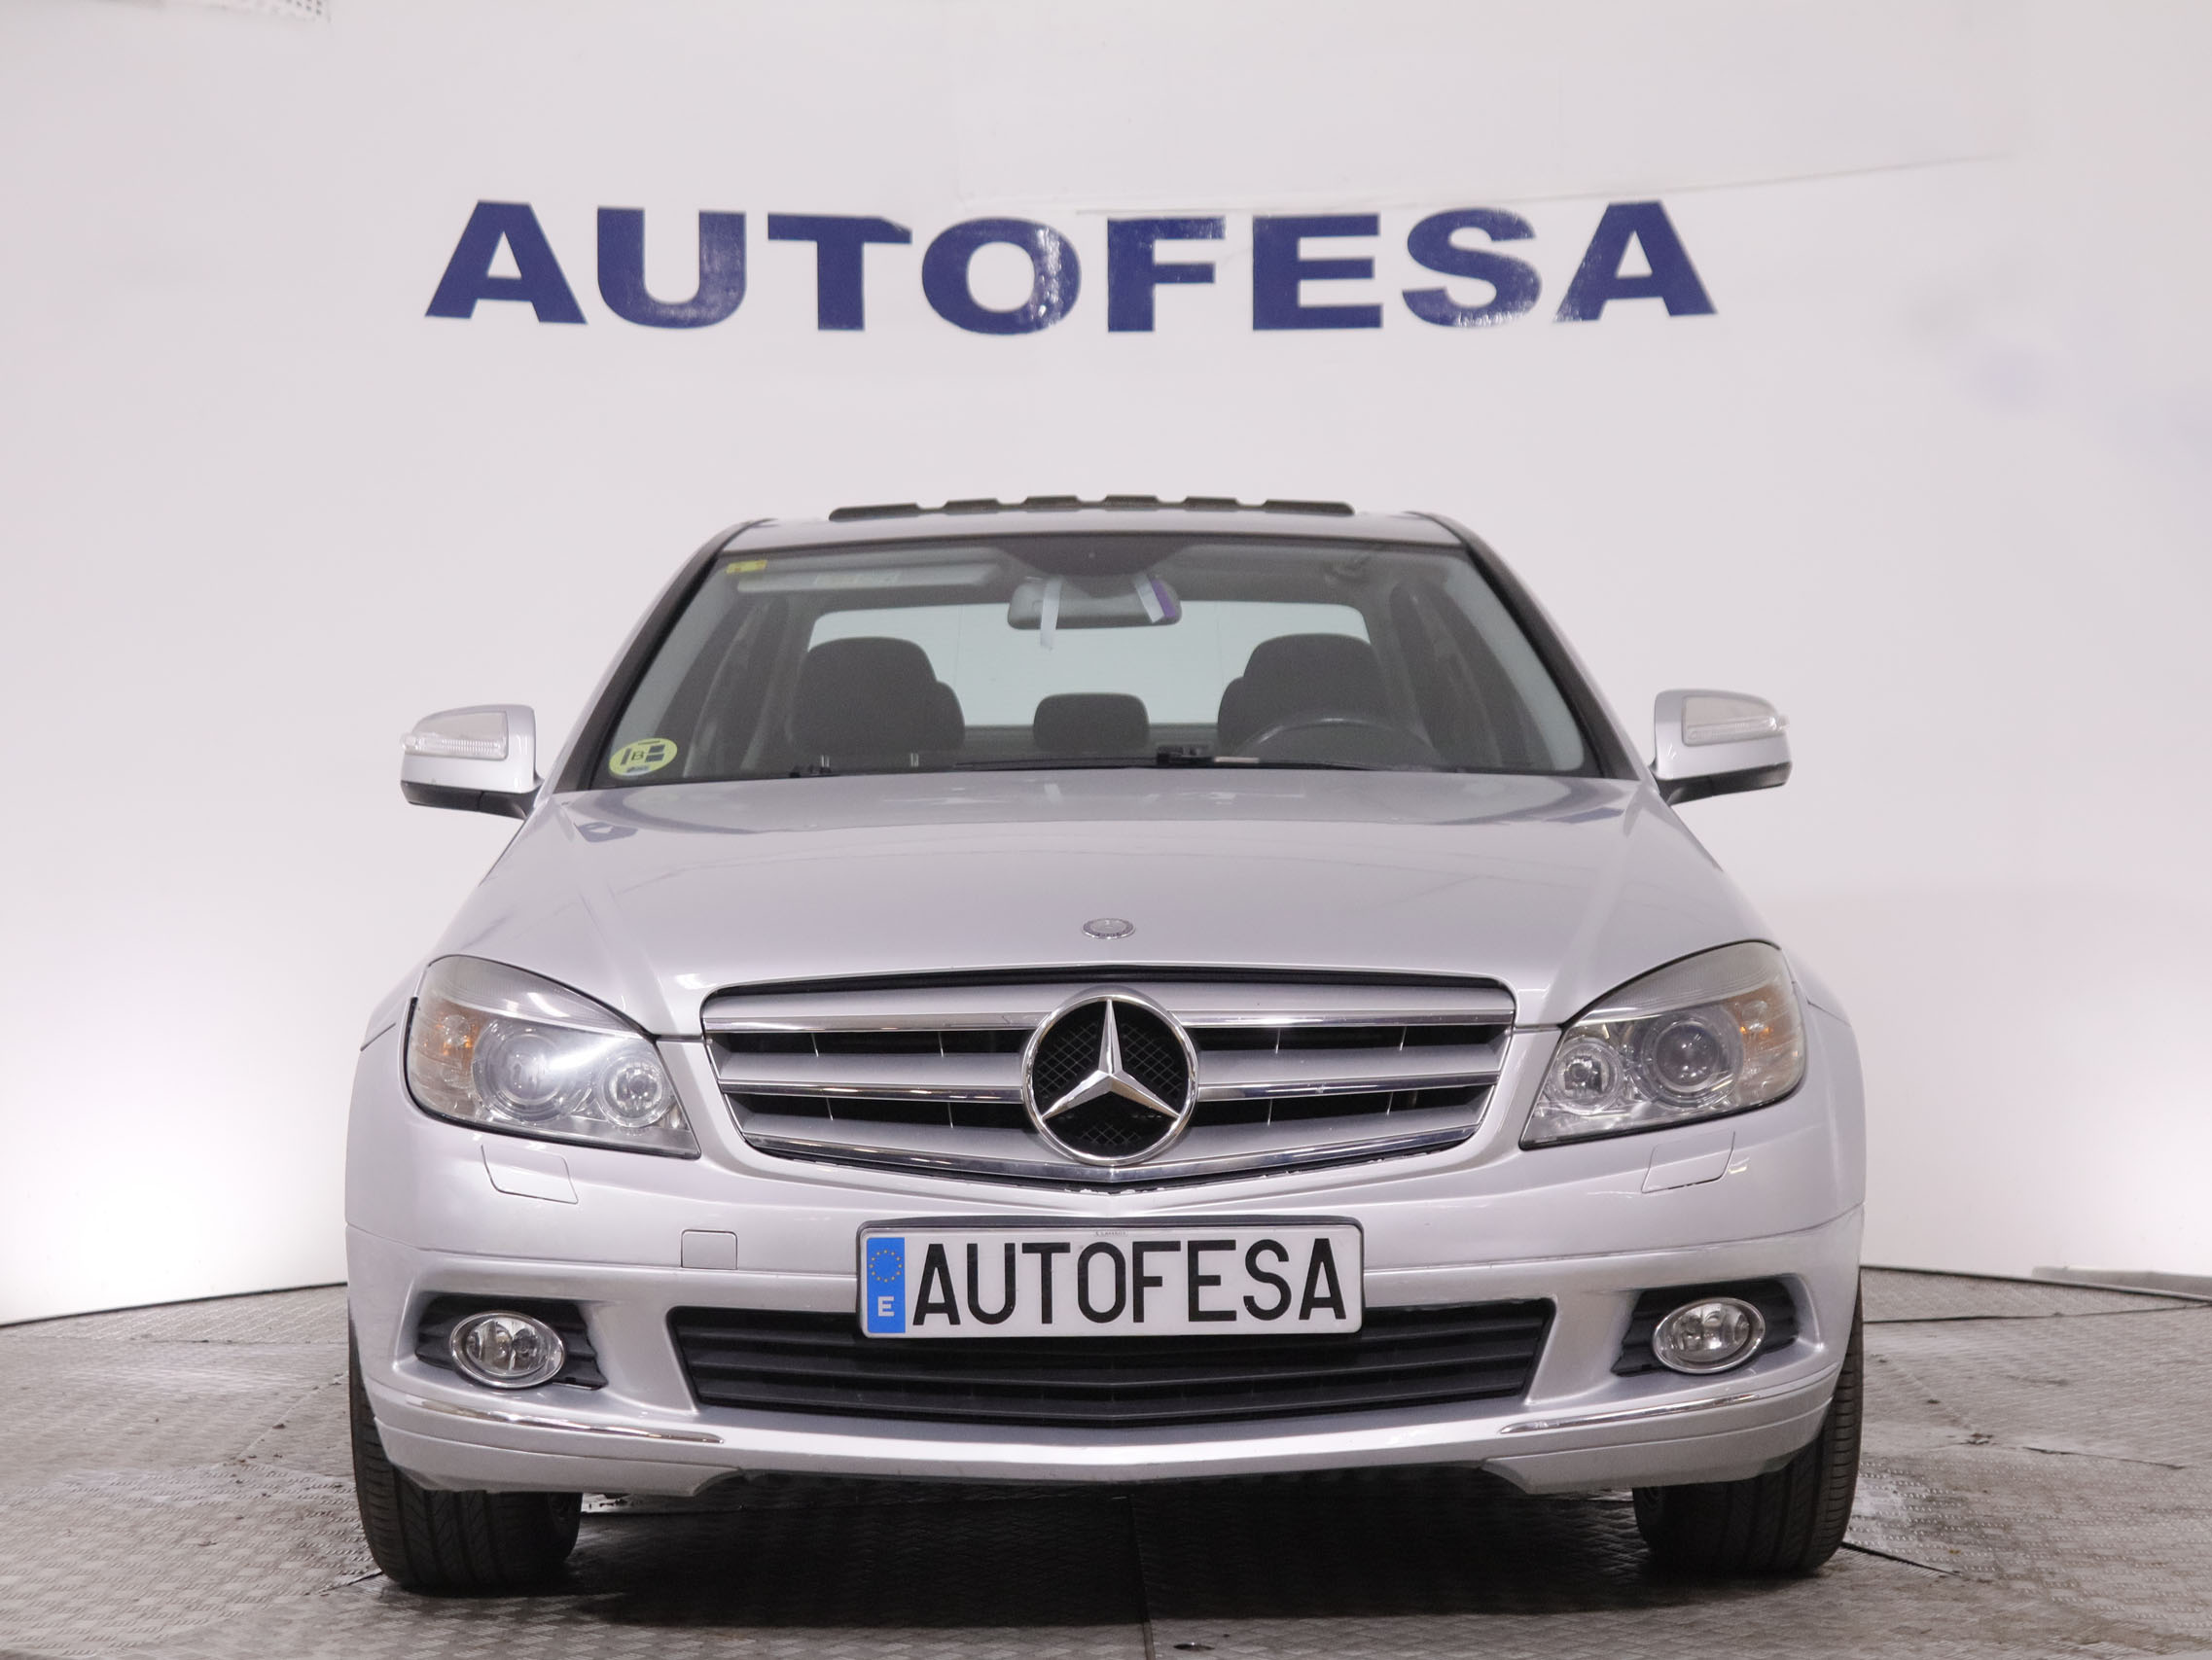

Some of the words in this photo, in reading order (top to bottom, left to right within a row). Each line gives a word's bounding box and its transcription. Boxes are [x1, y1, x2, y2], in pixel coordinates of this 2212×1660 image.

[425, 200, 1715, 336] AUTOFESA
[877, 1295, 895, 1317] E
[912, 1238, 1347, 1326] AUTOFESA
